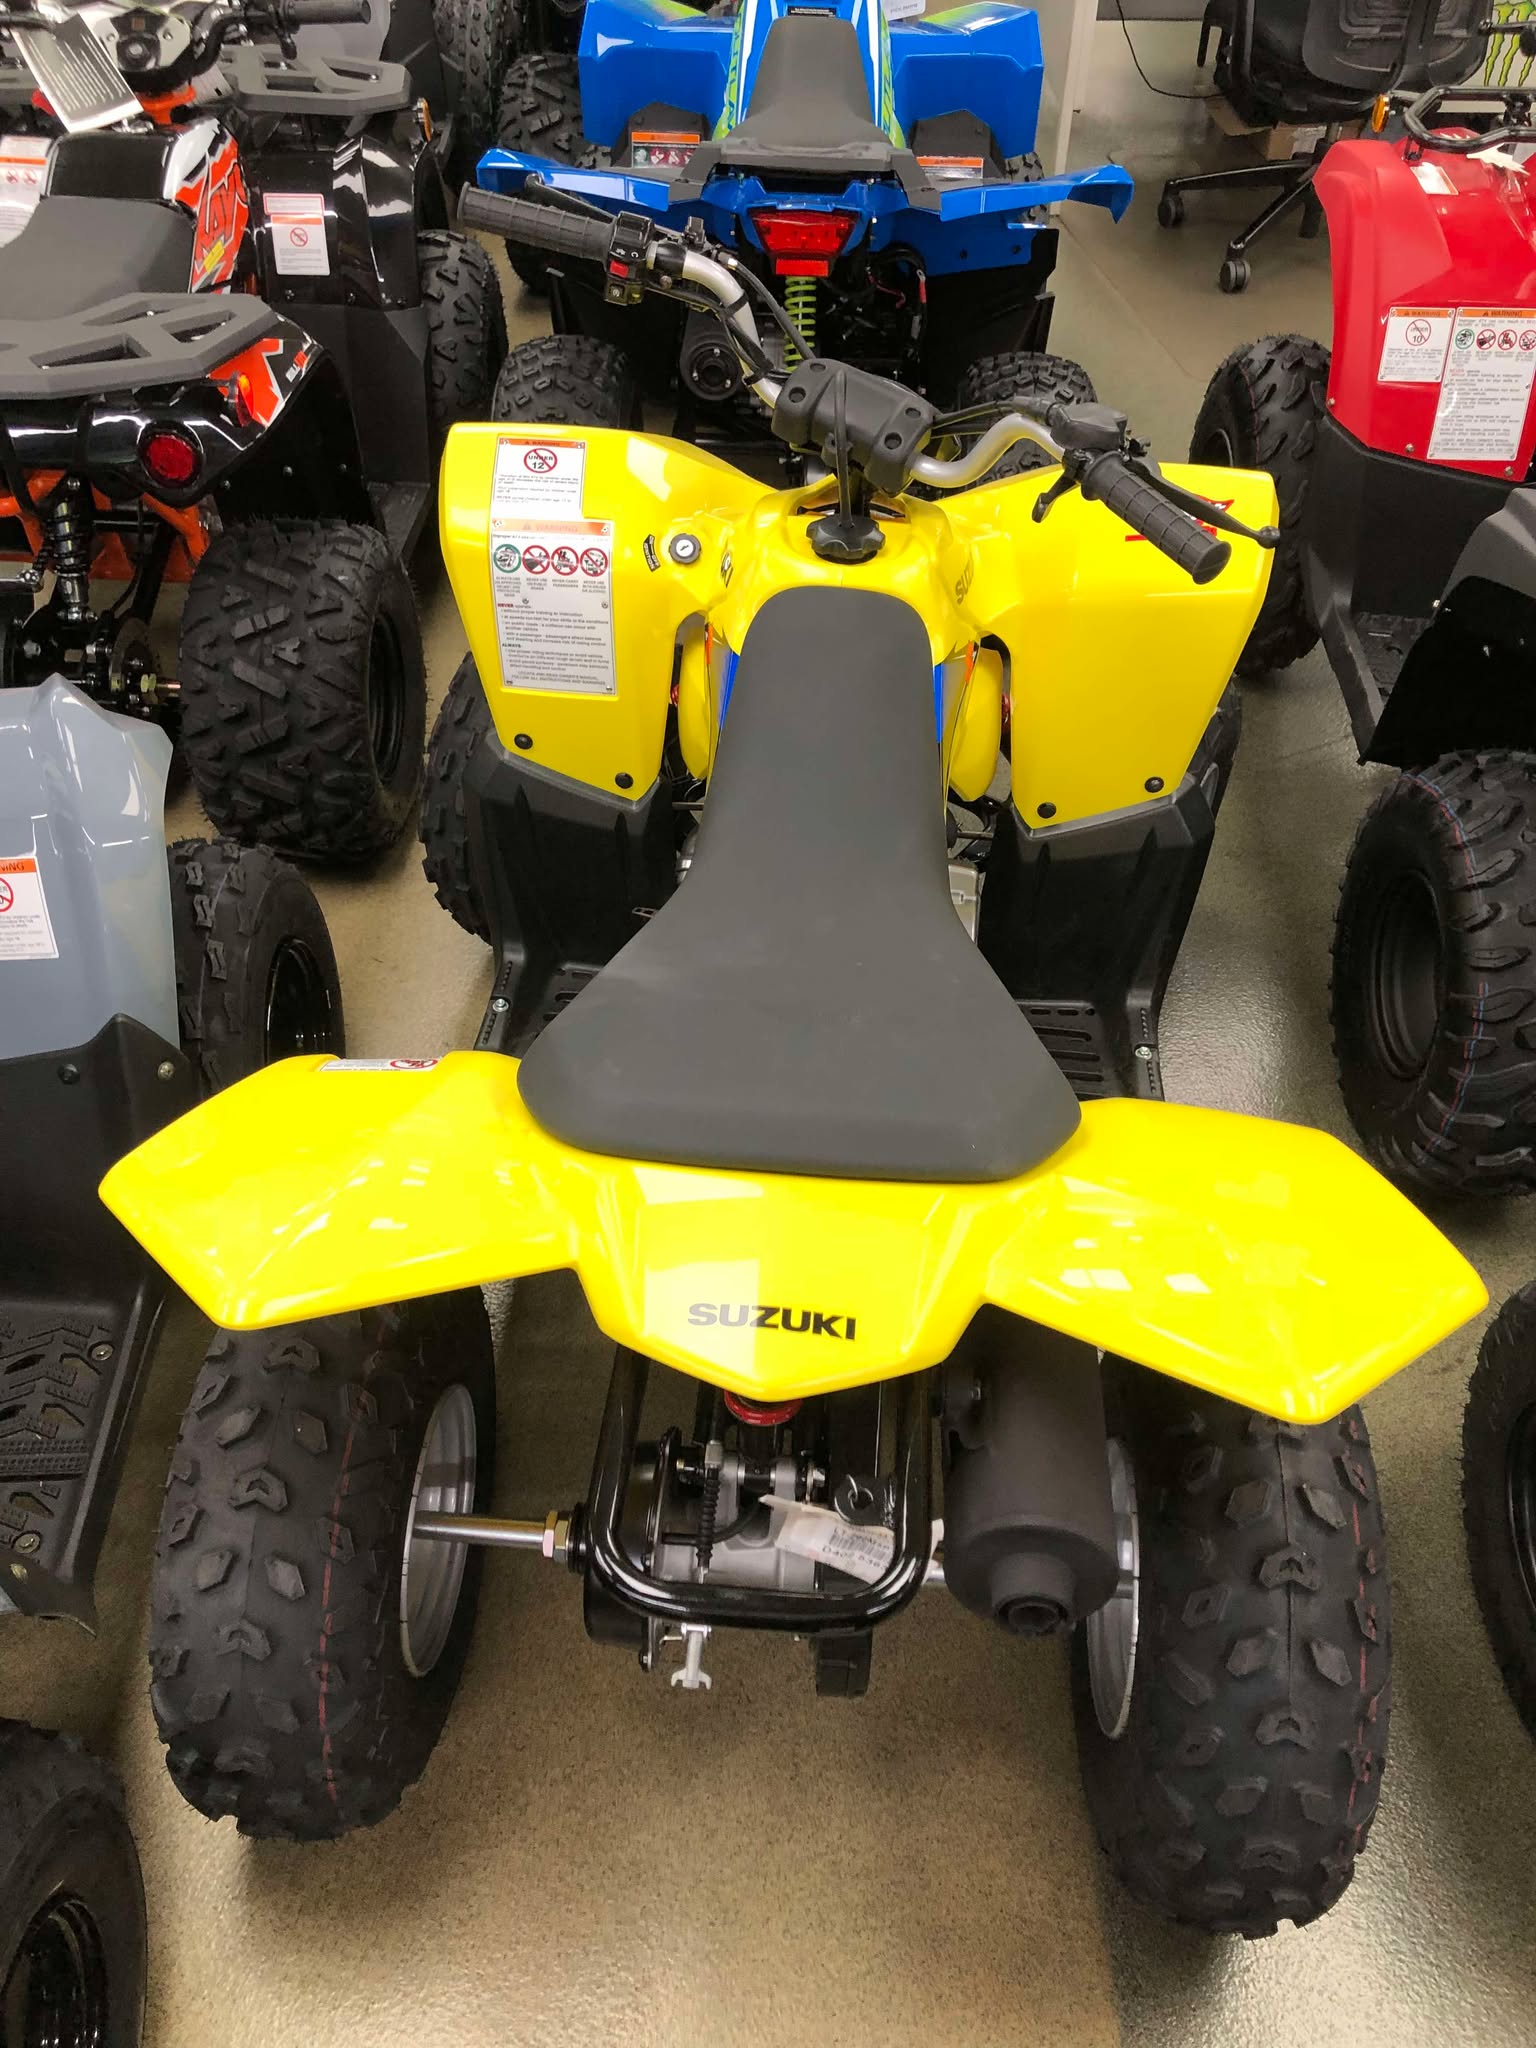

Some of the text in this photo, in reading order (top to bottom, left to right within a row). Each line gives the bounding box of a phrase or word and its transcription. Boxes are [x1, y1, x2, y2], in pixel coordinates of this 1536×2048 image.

[1412, 335, 1423, 343] 10
[532, 461, 545, 470] 12
[687, 1303, 857, 1341] SUZUKI
